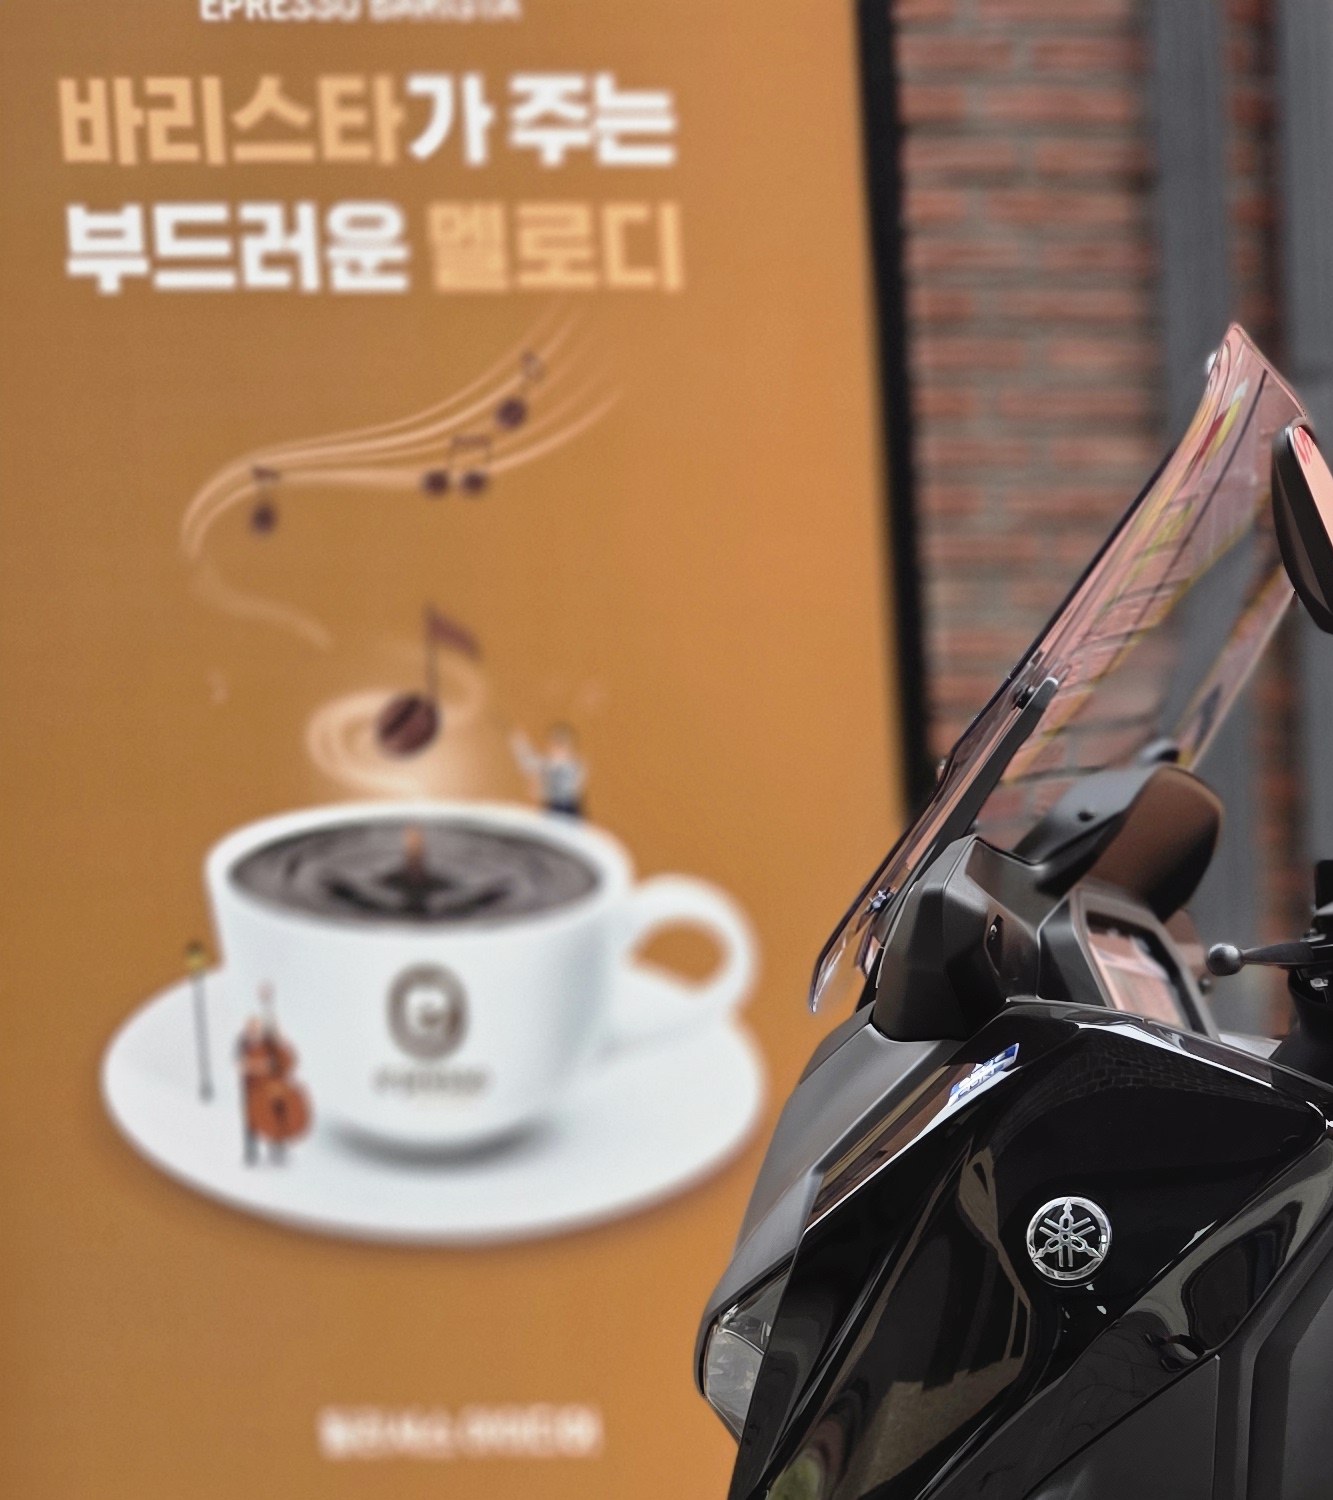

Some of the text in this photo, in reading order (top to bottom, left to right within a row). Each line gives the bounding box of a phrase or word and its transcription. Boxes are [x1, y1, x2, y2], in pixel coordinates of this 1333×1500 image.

[58, 72, 677, 166] 바리스타가 주는
[66, 202, 684, 294] 부드러운 멜로디
